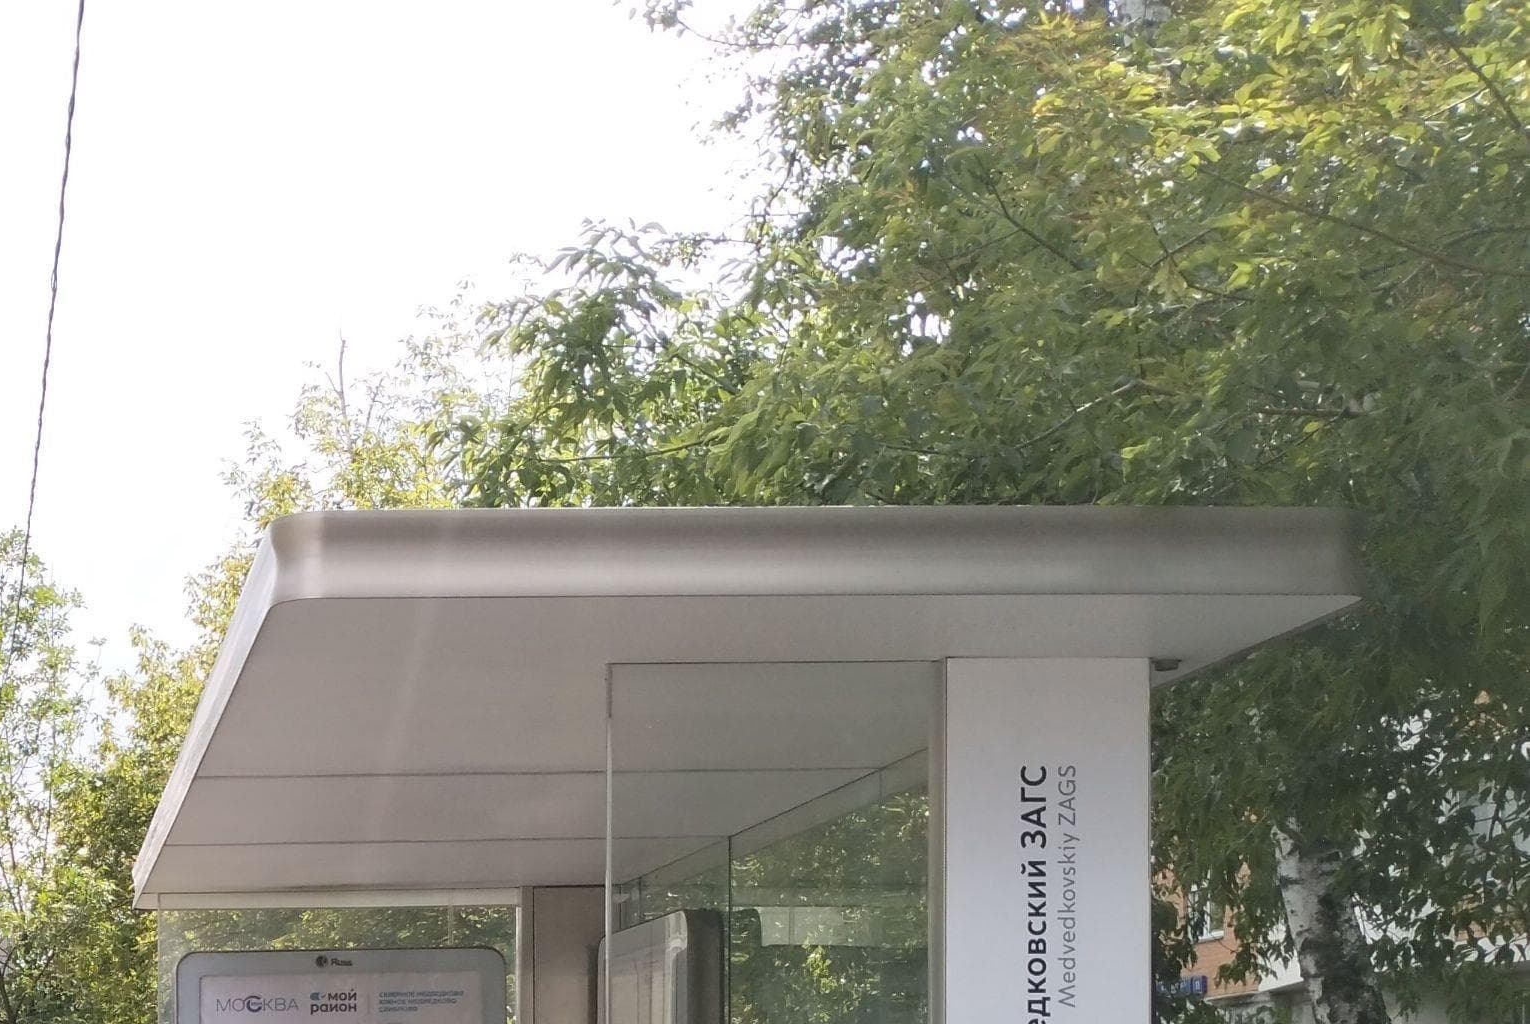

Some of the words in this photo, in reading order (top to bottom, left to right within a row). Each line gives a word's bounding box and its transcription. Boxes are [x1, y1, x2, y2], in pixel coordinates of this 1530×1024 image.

[1021, 765, 1047, 849] ЗАГС
[1058, 765, 1076, 826] ZAGS
[1058, 832, 1080, 1008] Medvedkovskiy
[216, 995, 299, 1013] МОСКВА
